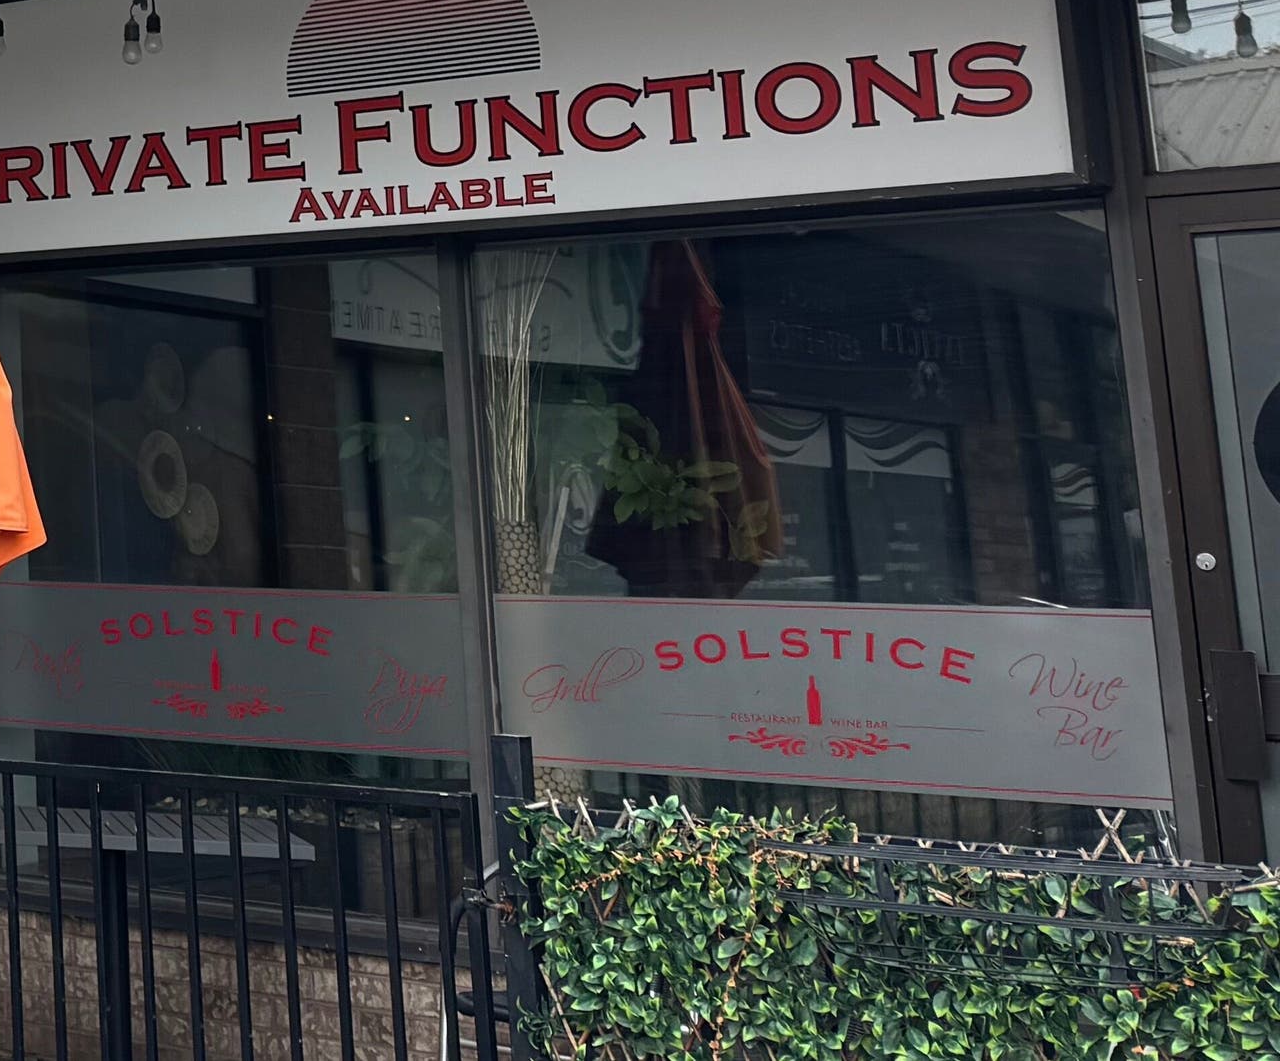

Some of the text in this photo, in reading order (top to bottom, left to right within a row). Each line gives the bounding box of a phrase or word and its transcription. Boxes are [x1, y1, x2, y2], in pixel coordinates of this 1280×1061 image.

[332, 40, 1033, 176] FUNCTIONS
[288, 169, 556, 224] AVAILABLE
[100, 608, 335, 657] SOLSTICE
[654, 627, 976, 685] SOLSTICE
[522, 647, 645, 714] Grill
[1008, 653, 1129, 711] Wine
[831, 718, 862, 729] WINE
[866, 720, 888, 729] BAR
[1036, 706, 1124, 761] Bar
